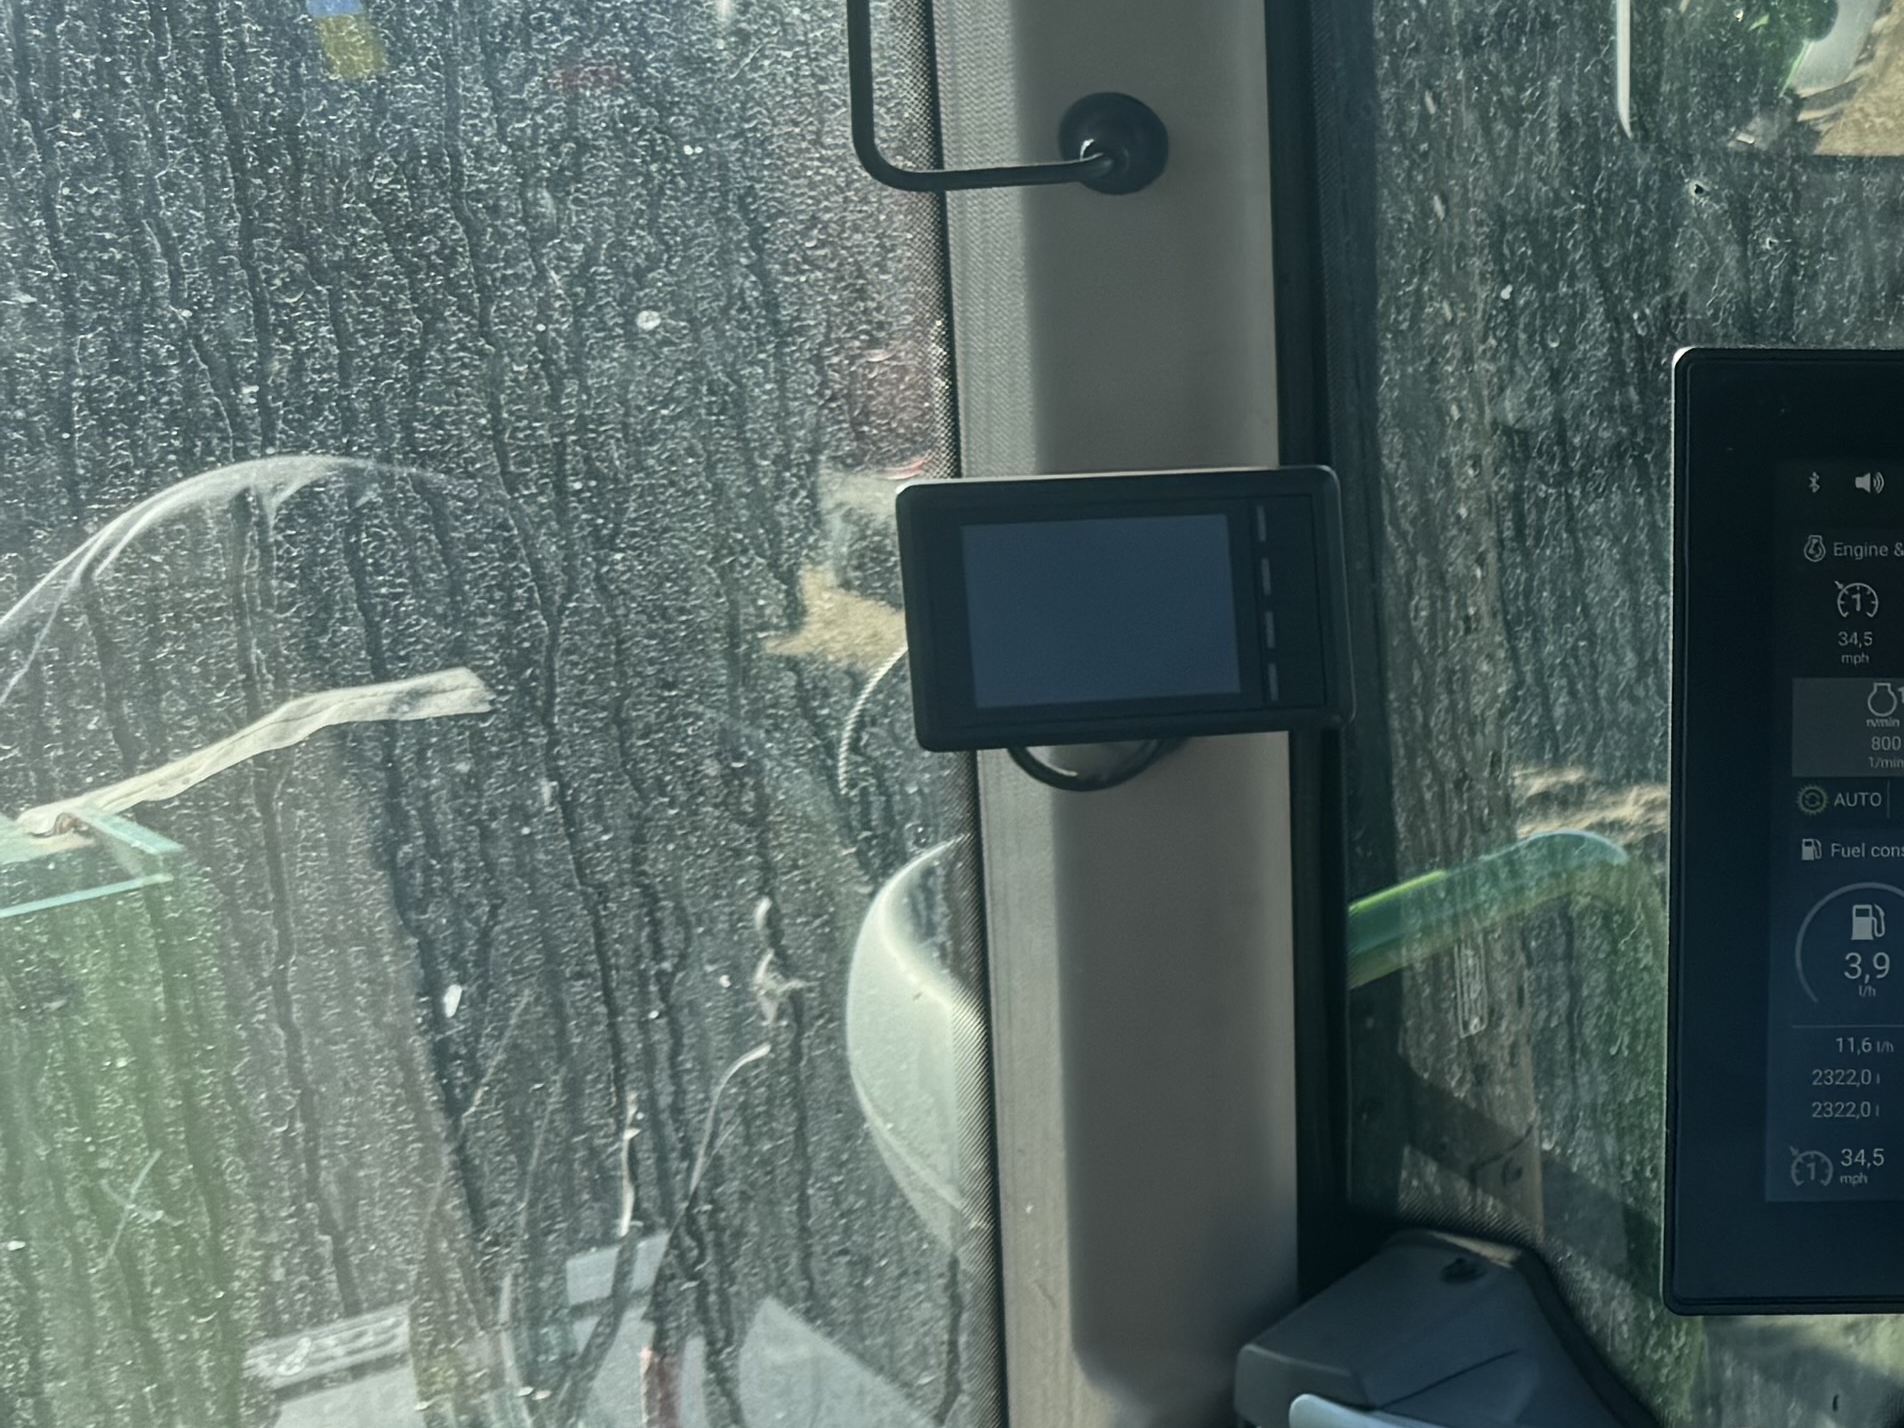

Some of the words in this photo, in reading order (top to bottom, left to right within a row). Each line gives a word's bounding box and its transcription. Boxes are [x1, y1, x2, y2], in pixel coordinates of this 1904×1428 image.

[1832, 542, 1889, 561] Engine
[1893, 542, 1904, 558] &
[1851, 594, 1862, 612] 1
[1837, 631, 1873, 649] 34,5
[1840, 652, 1870, 666] mph
[1870, 735, 1902, 751] 800
[1867, 756, 1904, 769] 1/min
[1833, 792, 1883, 808] AUTO
[1830, 842, 1866, 859] Fuel
[1843, 951, 1891, 984] 3,9
[1858, 983, 1877, 998] l/h
[1835, 1036, 1873, 1055] 11,6
[1876, 1039, 1895, 1054] l/h
[1811, 1069, 1872, 1087] 2322,0
[1811, 1102, 1872, 1120] 2322,0
[1840, 1148, 1885, 1169] 34,5
[1839, 1172, 1869, 1186] mph
